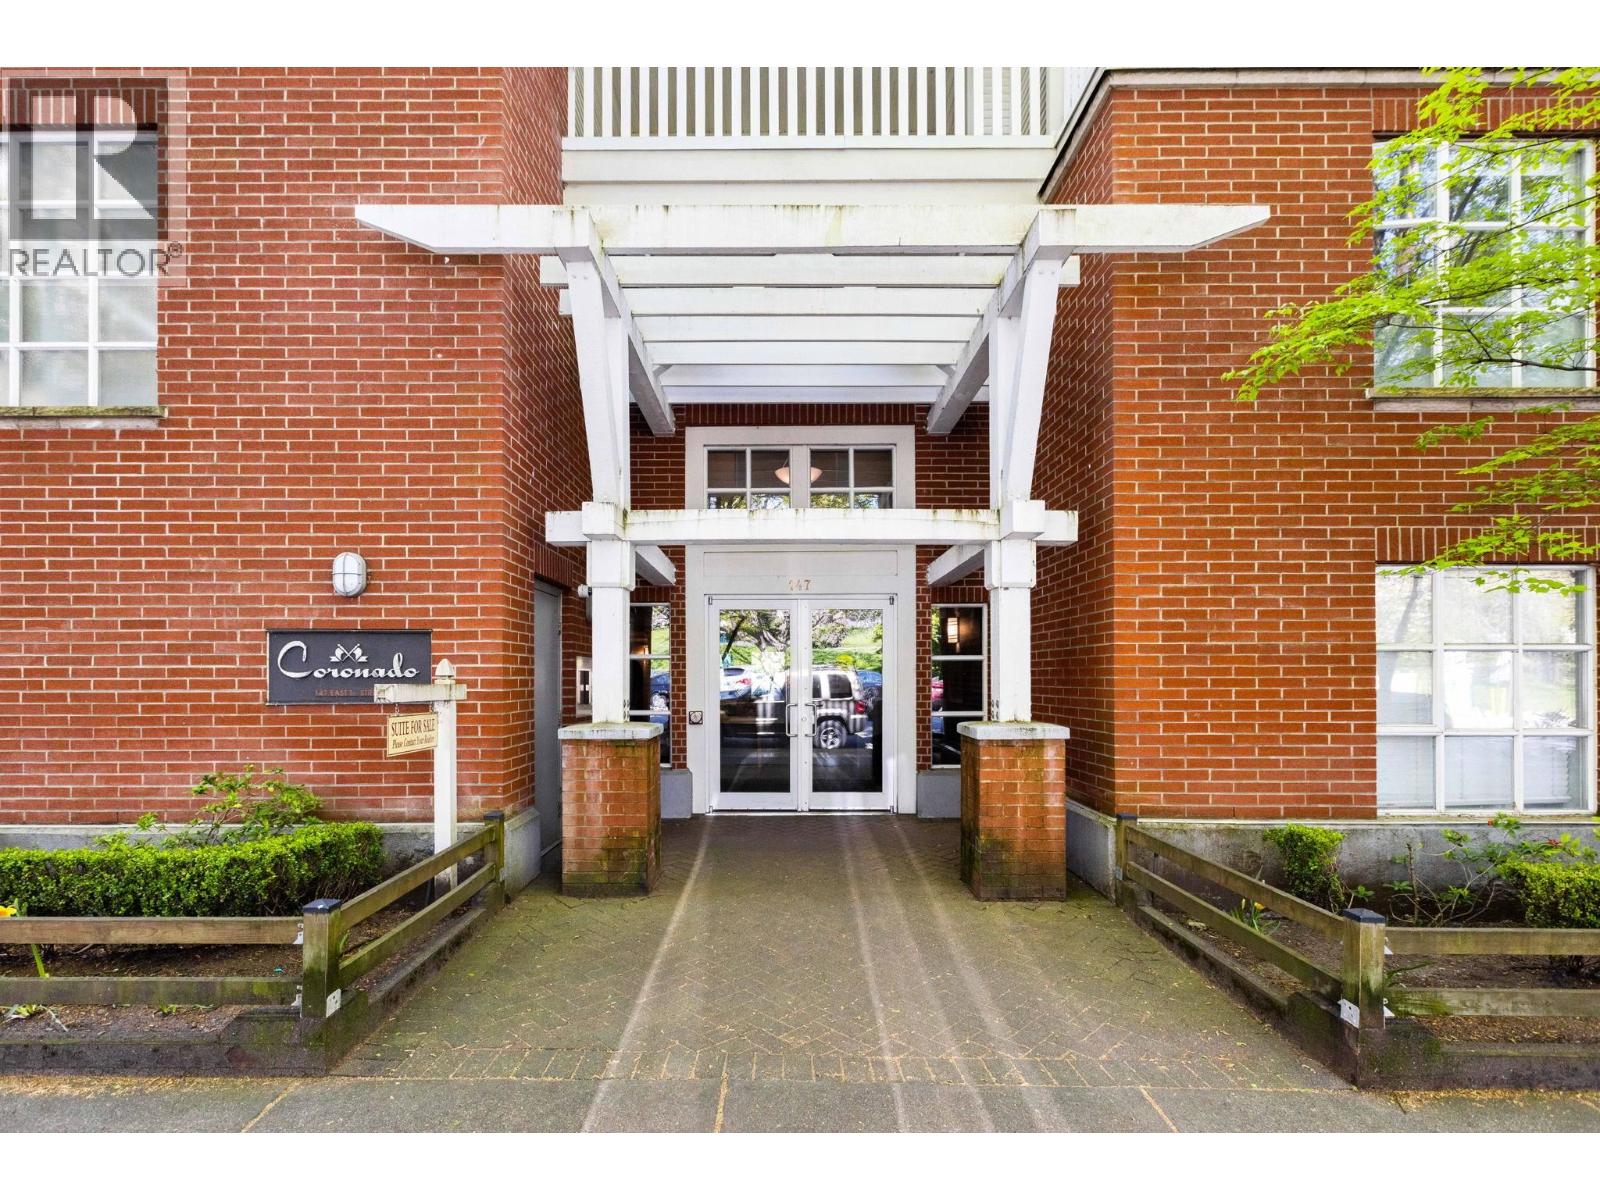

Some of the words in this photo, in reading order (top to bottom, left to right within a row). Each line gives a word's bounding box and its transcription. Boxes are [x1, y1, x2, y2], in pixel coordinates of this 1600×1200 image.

[277, 640, 420, 679] Coronado
[391, 721, 410, 737] SUITE
[410, 719, 423, 735] FOR
[423, 718, 436, 733] SALE
